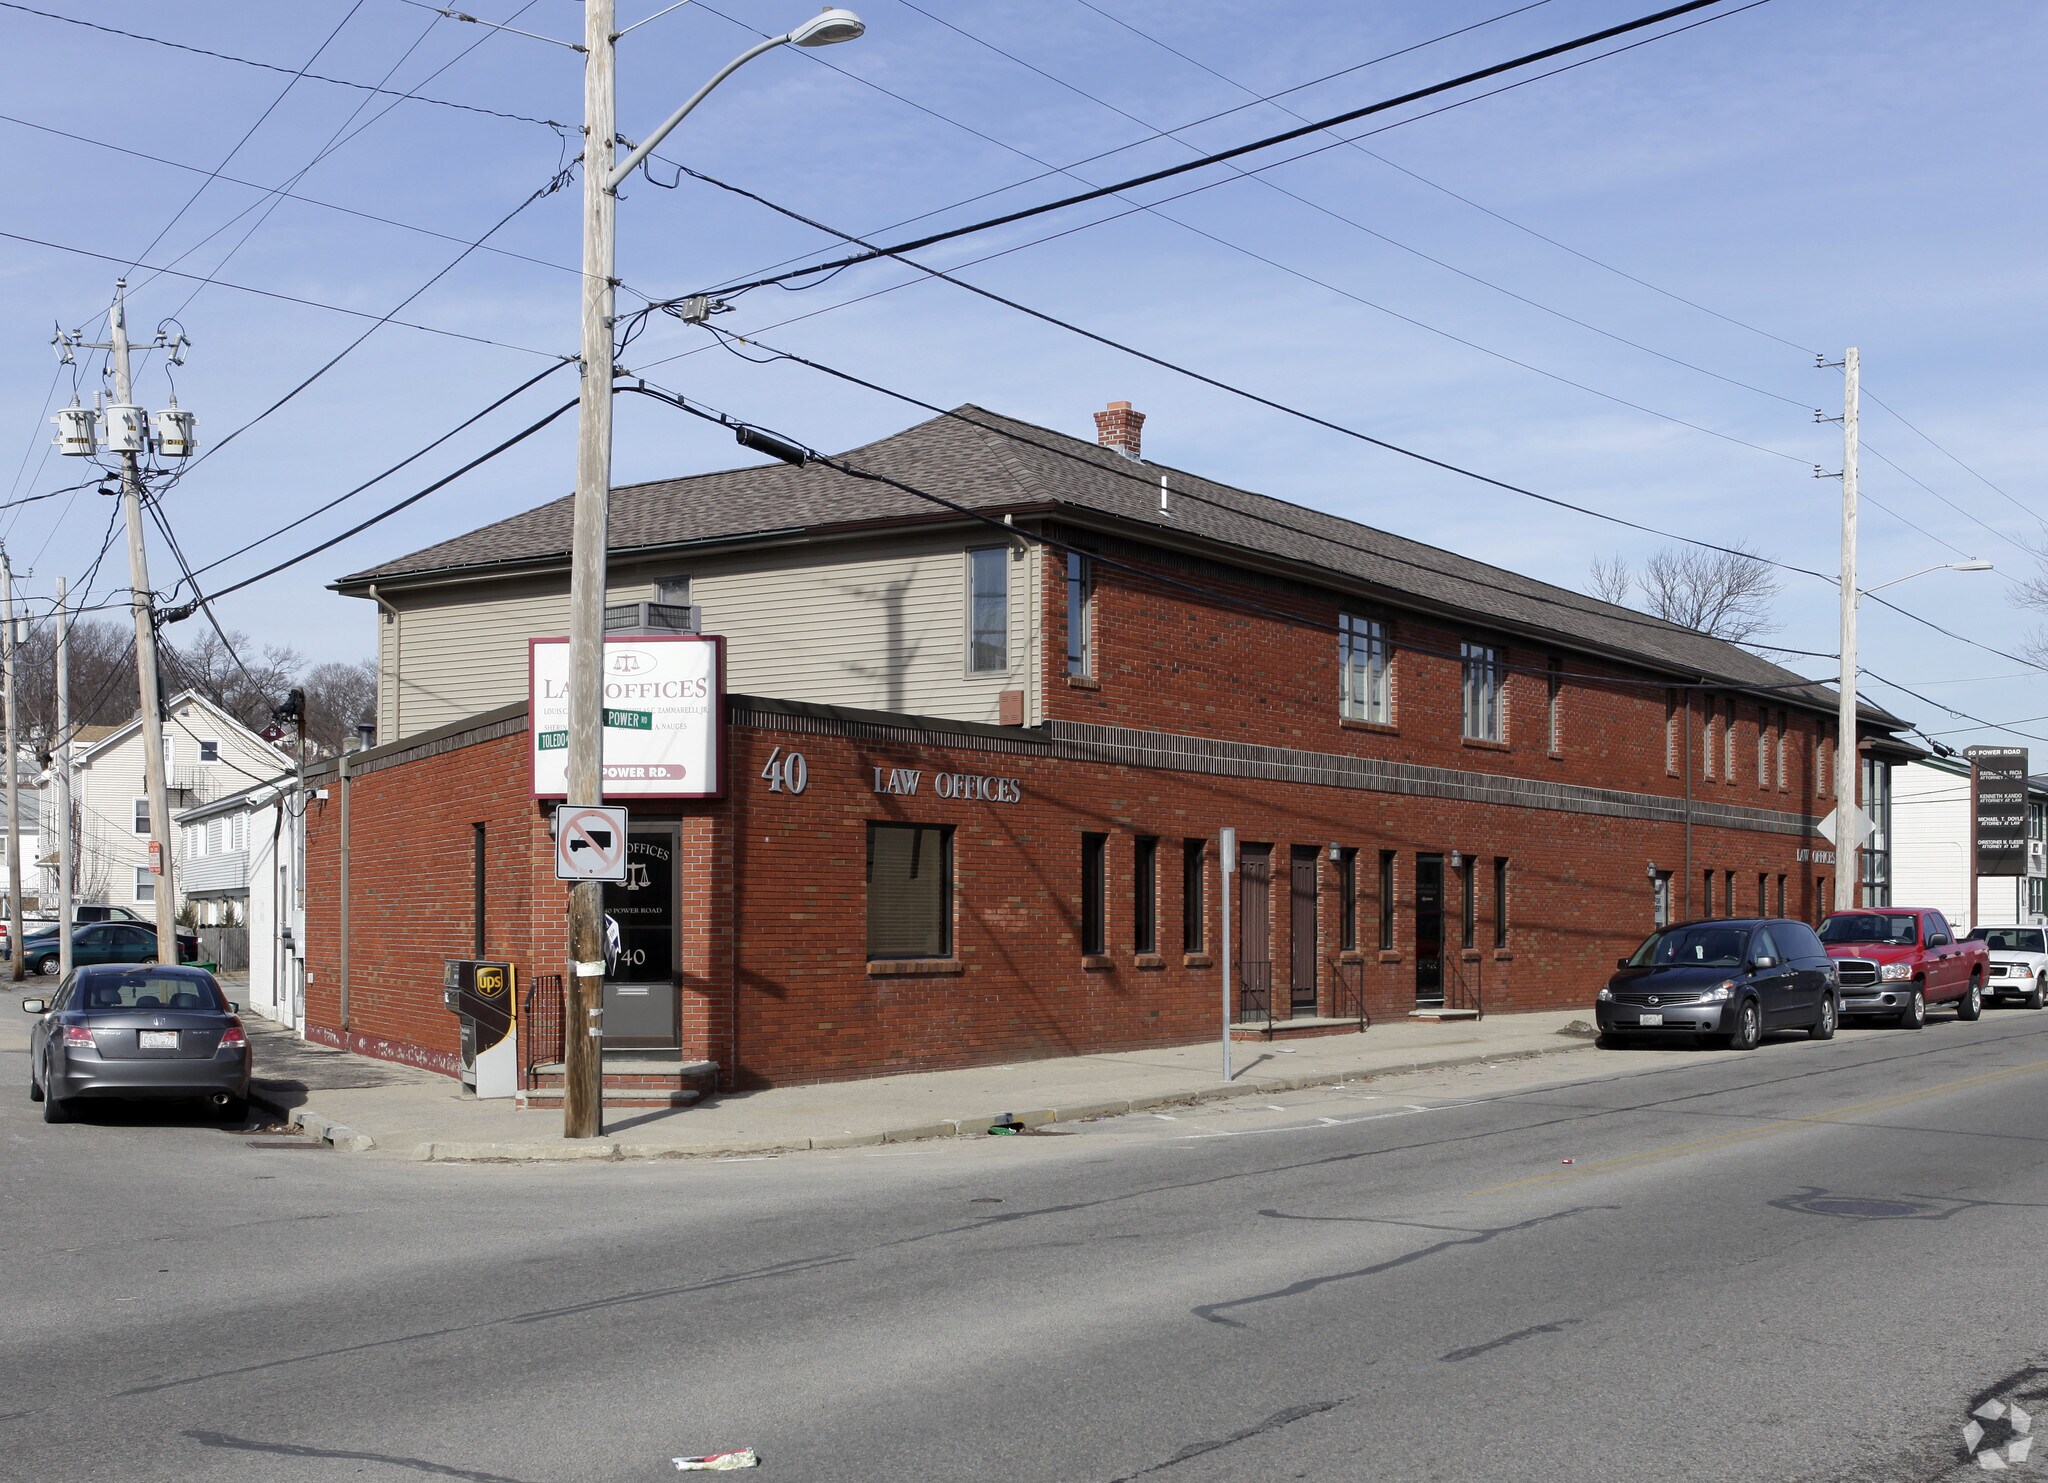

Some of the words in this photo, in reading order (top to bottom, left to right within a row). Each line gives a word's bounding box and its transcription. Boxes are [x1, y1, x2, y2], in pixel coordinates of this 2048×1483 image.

[543, 679, 569, 699] LA
[605, 677, 708, 699] OFFICES
[608, 710, 639, 727] POWER
[641, 716, 648, 724] RD
[661, 722, 687, 731] NAUGES
[541, 732, 566, 749] TOLEDO
[648, 766, 672, 778] RD.
[760, 746, 808, 795] 40
[872, 766, 922, 795] LAW
[934, 772, 1021, 804] OFFICES
[627, 842, 670, 861] OFFICES
[1796, 848, 1809, 862] LAW
[1812, 850, 1836, 864] OFFICES
[620, 949, 646, 967] 40
[479, 976, 501, 993] ups
